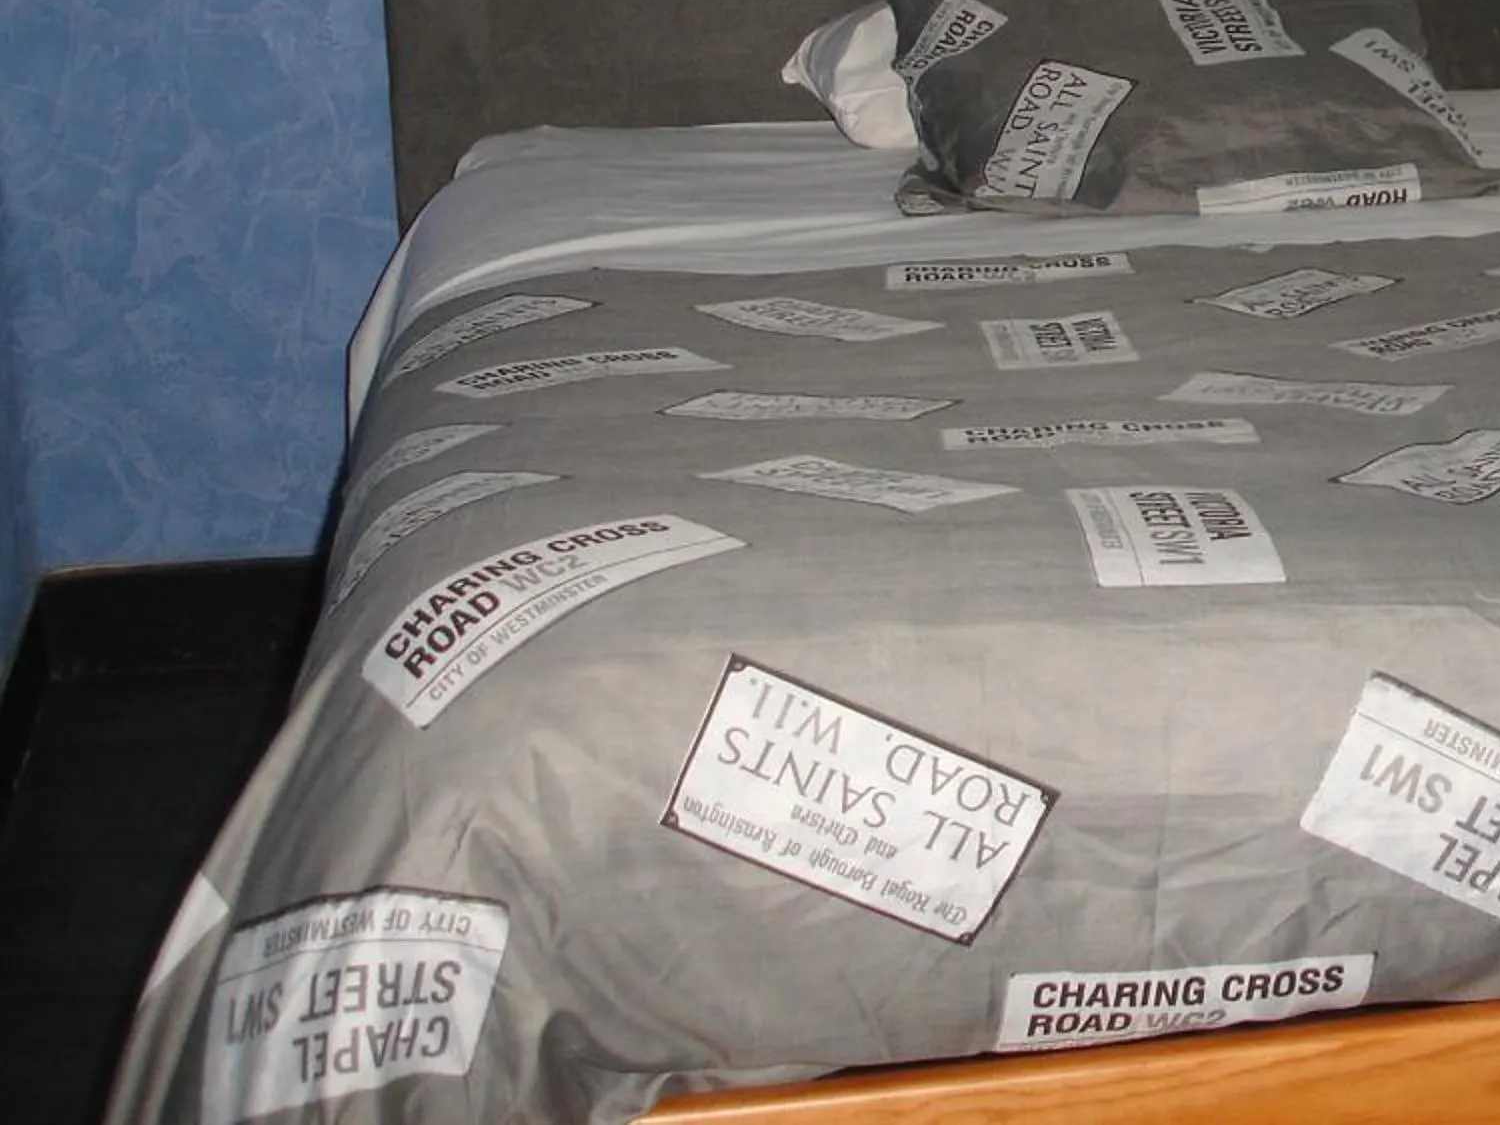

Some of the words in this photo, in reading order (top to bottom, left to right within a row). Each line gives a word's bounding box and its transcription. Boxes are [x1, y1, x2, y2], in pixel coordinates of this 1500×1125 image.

[1050, 72, 1087, 110] ALL
[1150, 529, 1206, 565] SW1
[384, 550, 543, 660] CHARING
[547, 521, 672, 555] CROSS
[403, 590, 501, 680] ROAD
[499, 554, 592, 593] WC2
[428, 665, 467, 702] CITY
[466, 642, 490, 667] OF
[492, 573, 609, 646] WESTMINSTER
[716, 726, 898, 830] SAINTS
[884, 732, 1032, 830] ROAD,
[1359, 742, 1454, 816] SW1
[923, 808, 1013, 871] ALL
[381, 908, 415, 933] OF
[418, 910, 474, 937] CITY
[297, 959, 462, 1024] STREET
[1032, 975, 1208, 1010] CHARING
[1222, 963, 1346, 1003] CROSS
[291, 1014, 452, 1084] CHAPEL
[1026, 1010, 1133, 1039] ROAD
